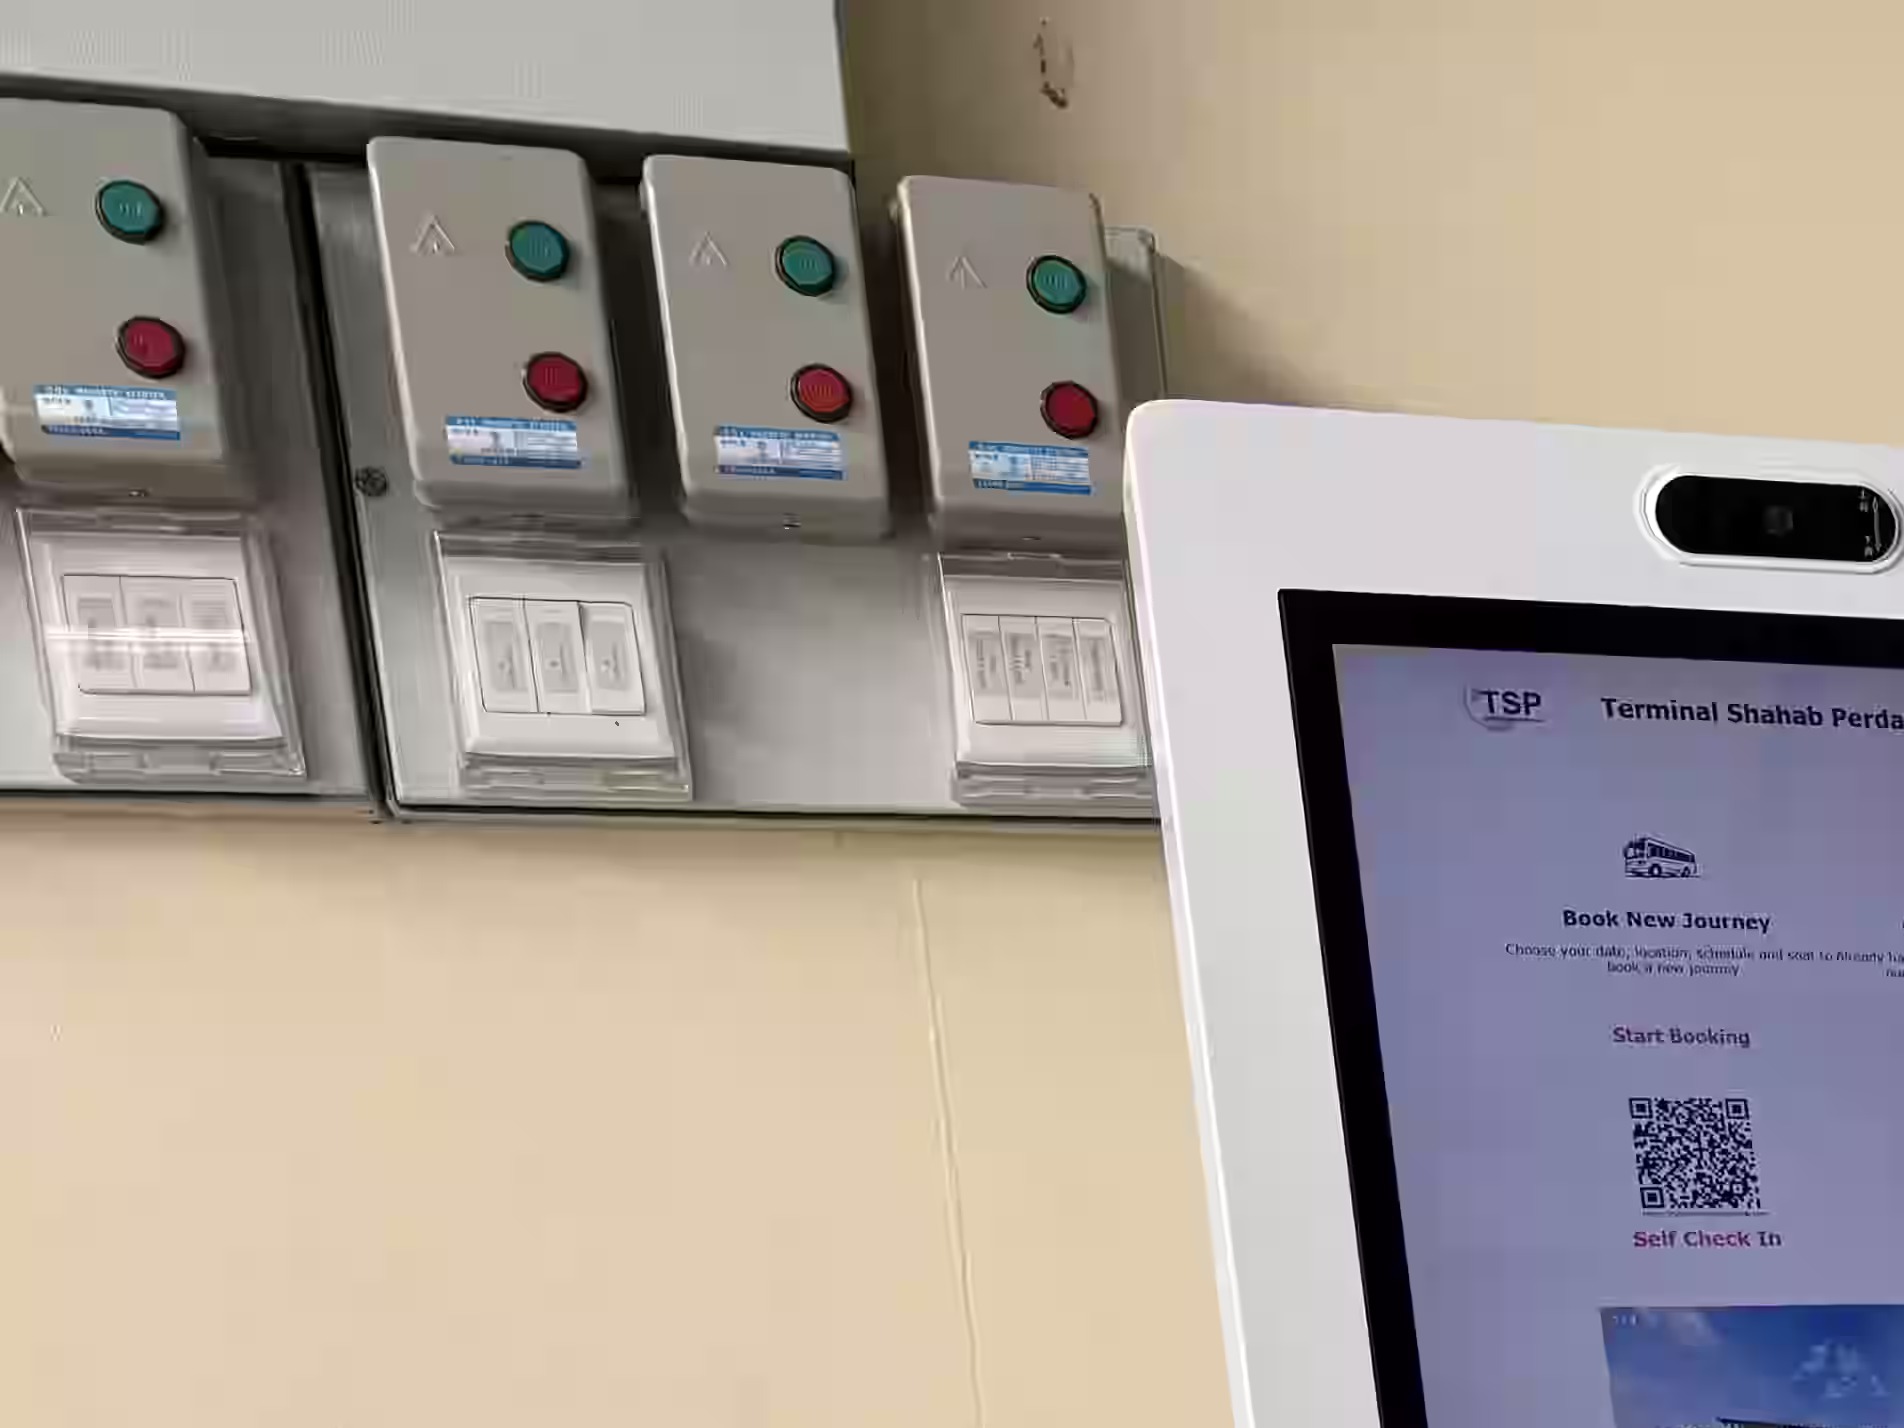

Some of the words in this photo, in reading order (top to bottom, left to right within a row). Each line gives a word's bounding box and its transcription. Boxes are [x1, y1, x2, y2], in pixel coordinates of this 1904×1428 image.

[1482, 690, 1541, 716] TSP
[1601, 698, 1718, 723] Terminal
[1728, 703, 1823, 727] Shahab
[1562, 909, 1619, 928] Book
[1627, 911, 1675, 928] New
[1682, 912, 1771, 933] Journey
[1612, 1026, 1665, 1044] Start
[1670, 1028, 1751, 1048] Booking
[1633, 1230, 1678, 1248] Self
[1683, 1229, 1751, 1247] Check
[1757, 1231, 1782, 1247] In
